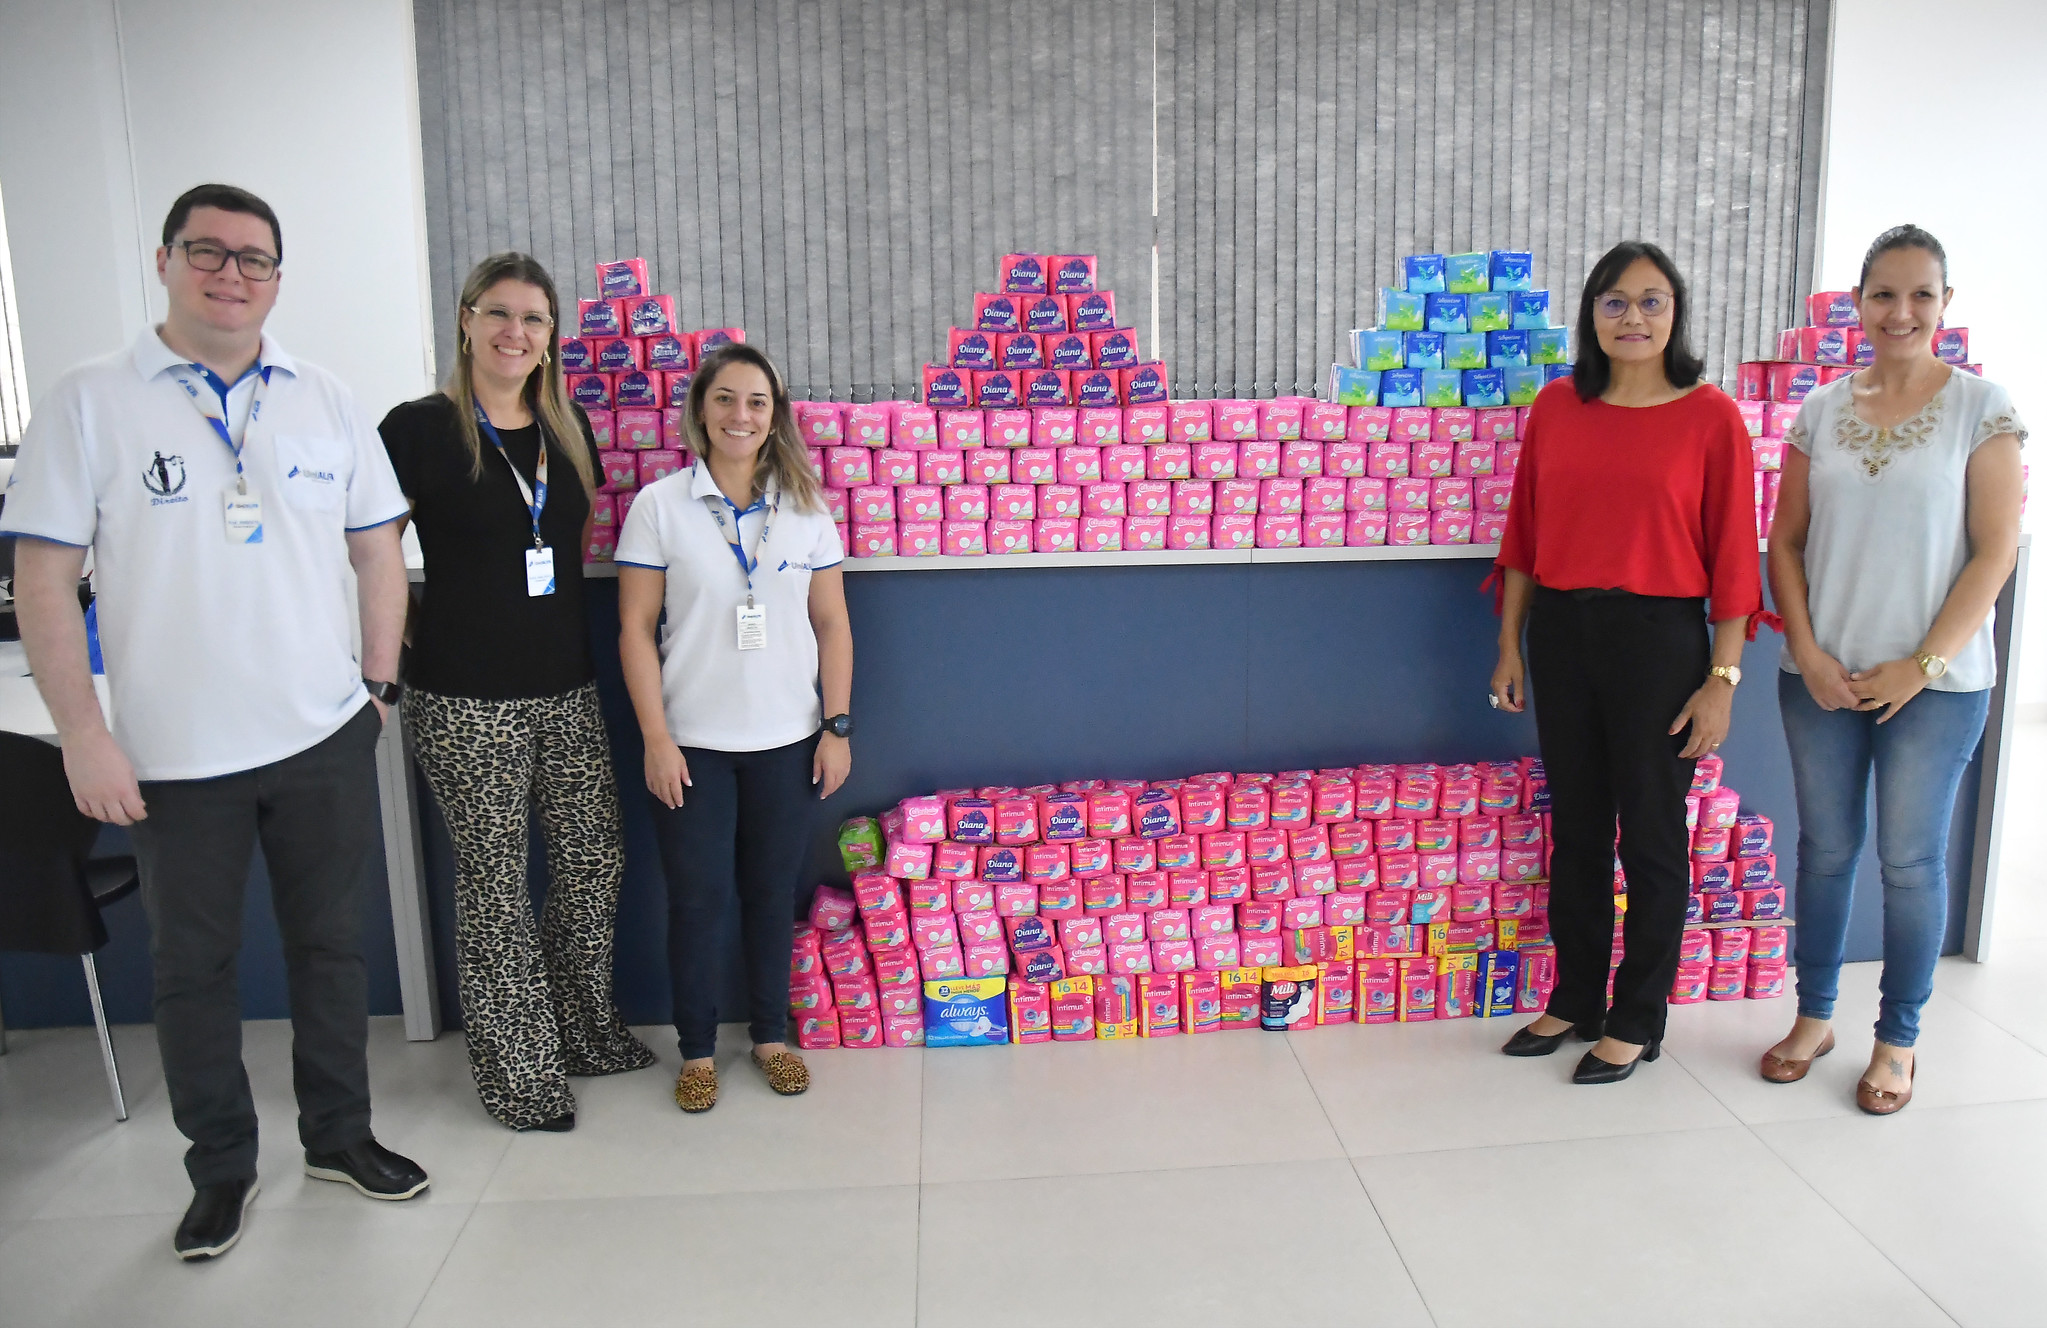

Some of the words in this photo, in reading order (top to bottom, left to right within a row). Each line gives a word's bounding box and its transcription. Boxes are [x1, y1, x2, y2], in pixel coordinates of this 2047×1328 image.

[1011, 269, 1037, 278] Diana
[1060, 270, 1085, 279] Diana
[984, 308, 1010, 318] Diana
[1078, 307, 1104, 316] Diana
[1829, 303, 1851, 313] Diana
[584, 312, 610, 322] Diana
[1030, 309, 1056, 319] Diana
[959, 345, 985, 355] Diana
[1007, 345, 1033, 355] Diana
[1101, 345, 1127, 355] Diana
[1938, 341, 1960, 351] Diana
[601, 352, 626, 361] Diana
[1055, 348, 1081, 358] Diana
[931, 382, 957, 392] Diana
[1131, 379, 1156, 390] Diana
[1792, 377, 1814, 387] Diana
[575, 386, 601, 396] Diana
[621, 383, 646, 392] Diana
[982, 385, 1008, 395] Diana
[1031, 383, 1057, 393] Diana
[1082, 384, 1107, 394] Diana
[1051, 816, 1077, 825] Diana
[1142, 815, 1168, 825] Diana
[959, 821, 984, 830] Diana
[1742, 837, 1764, 845] Diana
[988, 860, 1013, 869] Diana
[1745, 869, 1767, 878] Diana
[1703, 875, 1726, 883] Diana
[1415, 892, 1433, 901] Mili
[1713, 901, 1735, 909] Diana
[1756, 902, 1777, 910] Diana
[1015, 928, 1041, 937] Diana
[1432, 929, 1446, 939] 16
[1502, 925, 1516, 936] 16
[1337, 930, 1347, 942] 16
[1430, 944, 1446, 955] 14
[1501, 941, 1516, 951] 14
[1027, 962, 1052, 973] Diana
[1228, 972, 1241, 982] 16
[1244, 972, 1257, 982] 14
[1057, 983, 1071, 993] 16
[1074, 981, 1088, 991] 14
[1270, 982, 1294, 996] Mili
[940, 1004, 987, 1020] always
[1104, 1025, 1116, 1038] 16
[1122, 1022, 1133, 1038] 14
